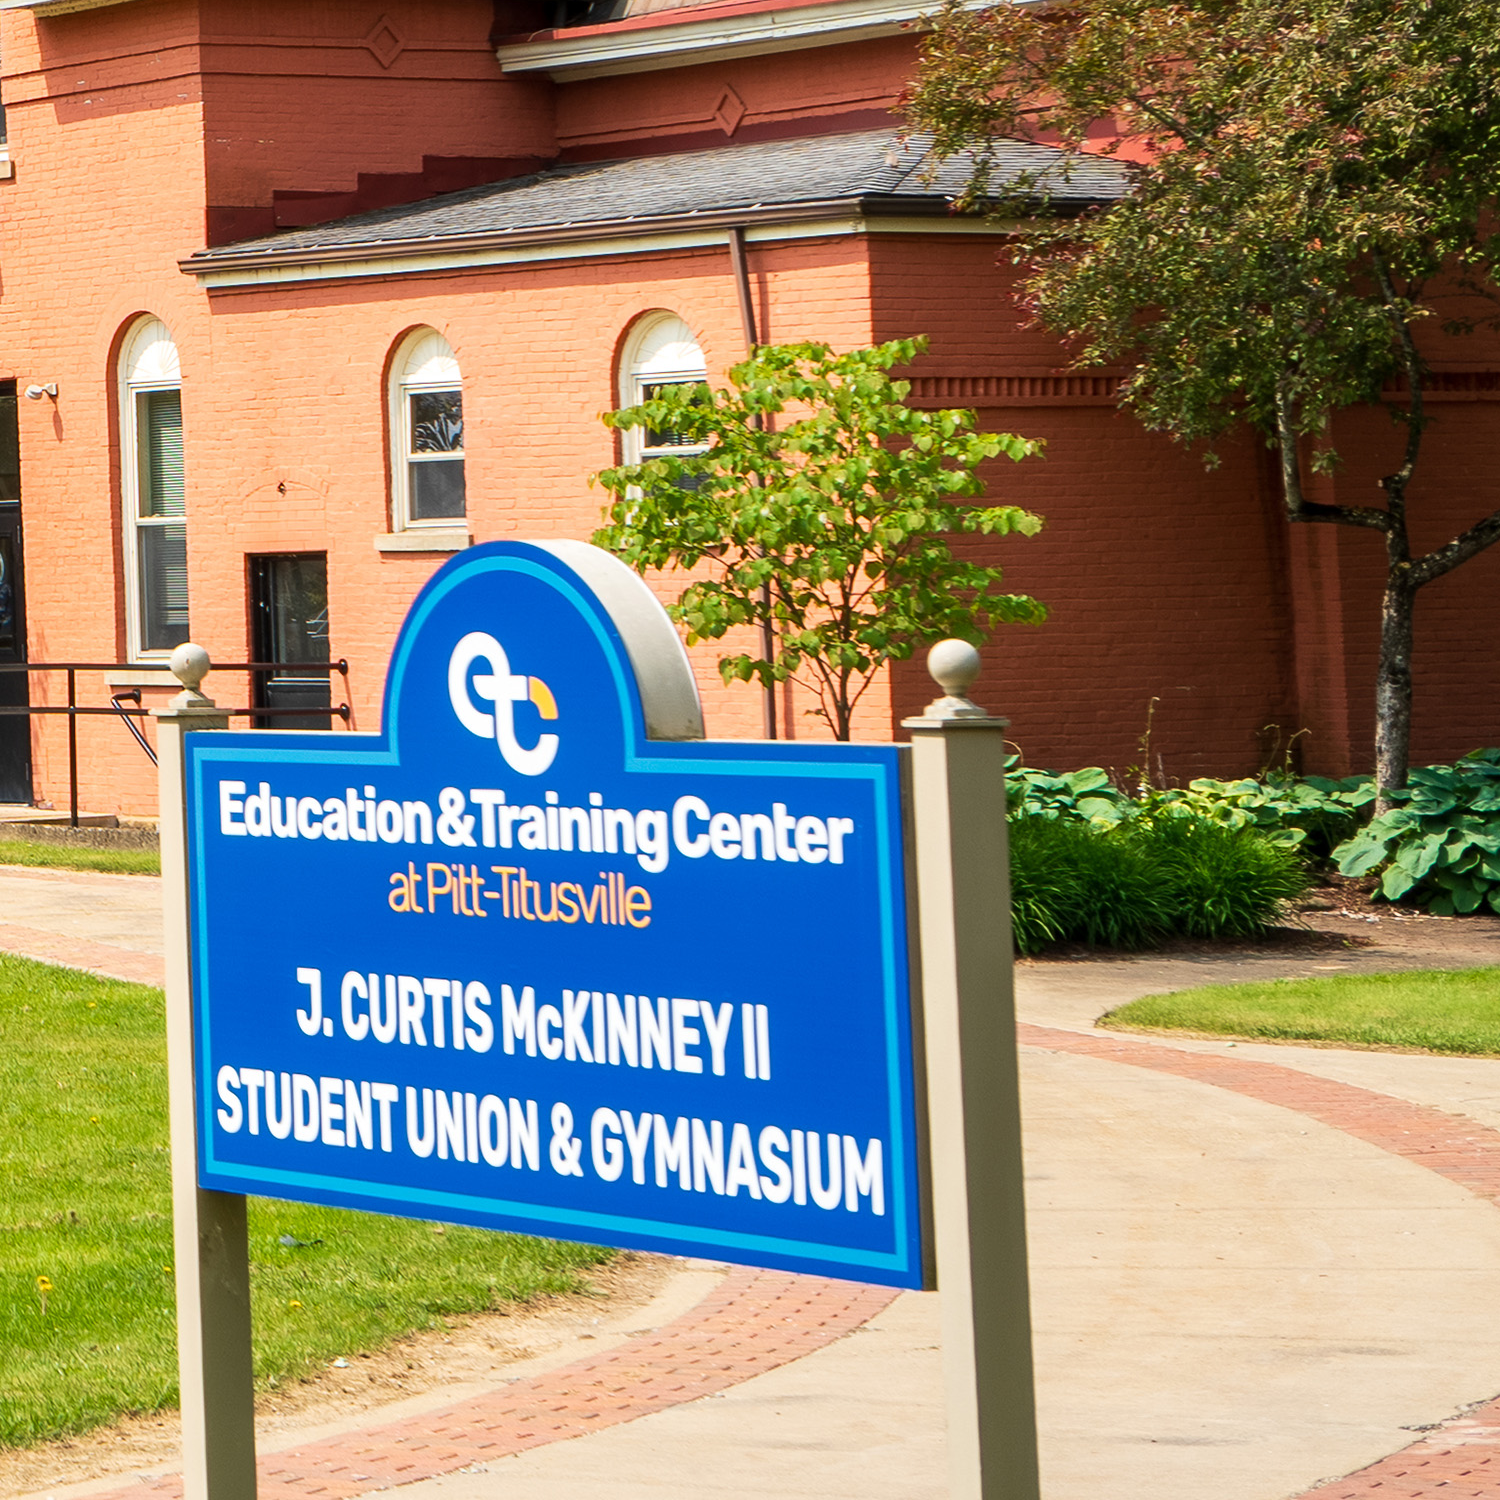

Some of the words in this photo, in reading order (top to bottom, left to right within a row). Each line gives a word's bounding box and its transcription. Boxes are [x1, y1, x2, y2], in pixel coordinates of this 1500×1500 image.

[219, 780, 431, 845] Education
[435, 786, 478, 849] &
[477, 789, 667, 873] Training
[672, 794, 855, 866] Center
[388, 862, 423, 914] at
[427, 862, 652, 929] Pitt-Titusville
[296, 966, 334, 1038] J.
[341, 970, 493, 1053] CURTIS
[502, 984, 731, 1077] McKINNEY
[743, 1002, 769, 1080] II
[217, 1066, 400, 1153] STUDENT
[405, 1085, 539, 1173] UNION
[551, 1102, 582, 1178] &
[592, 1109, 885, 1216] GYMNASIUM
